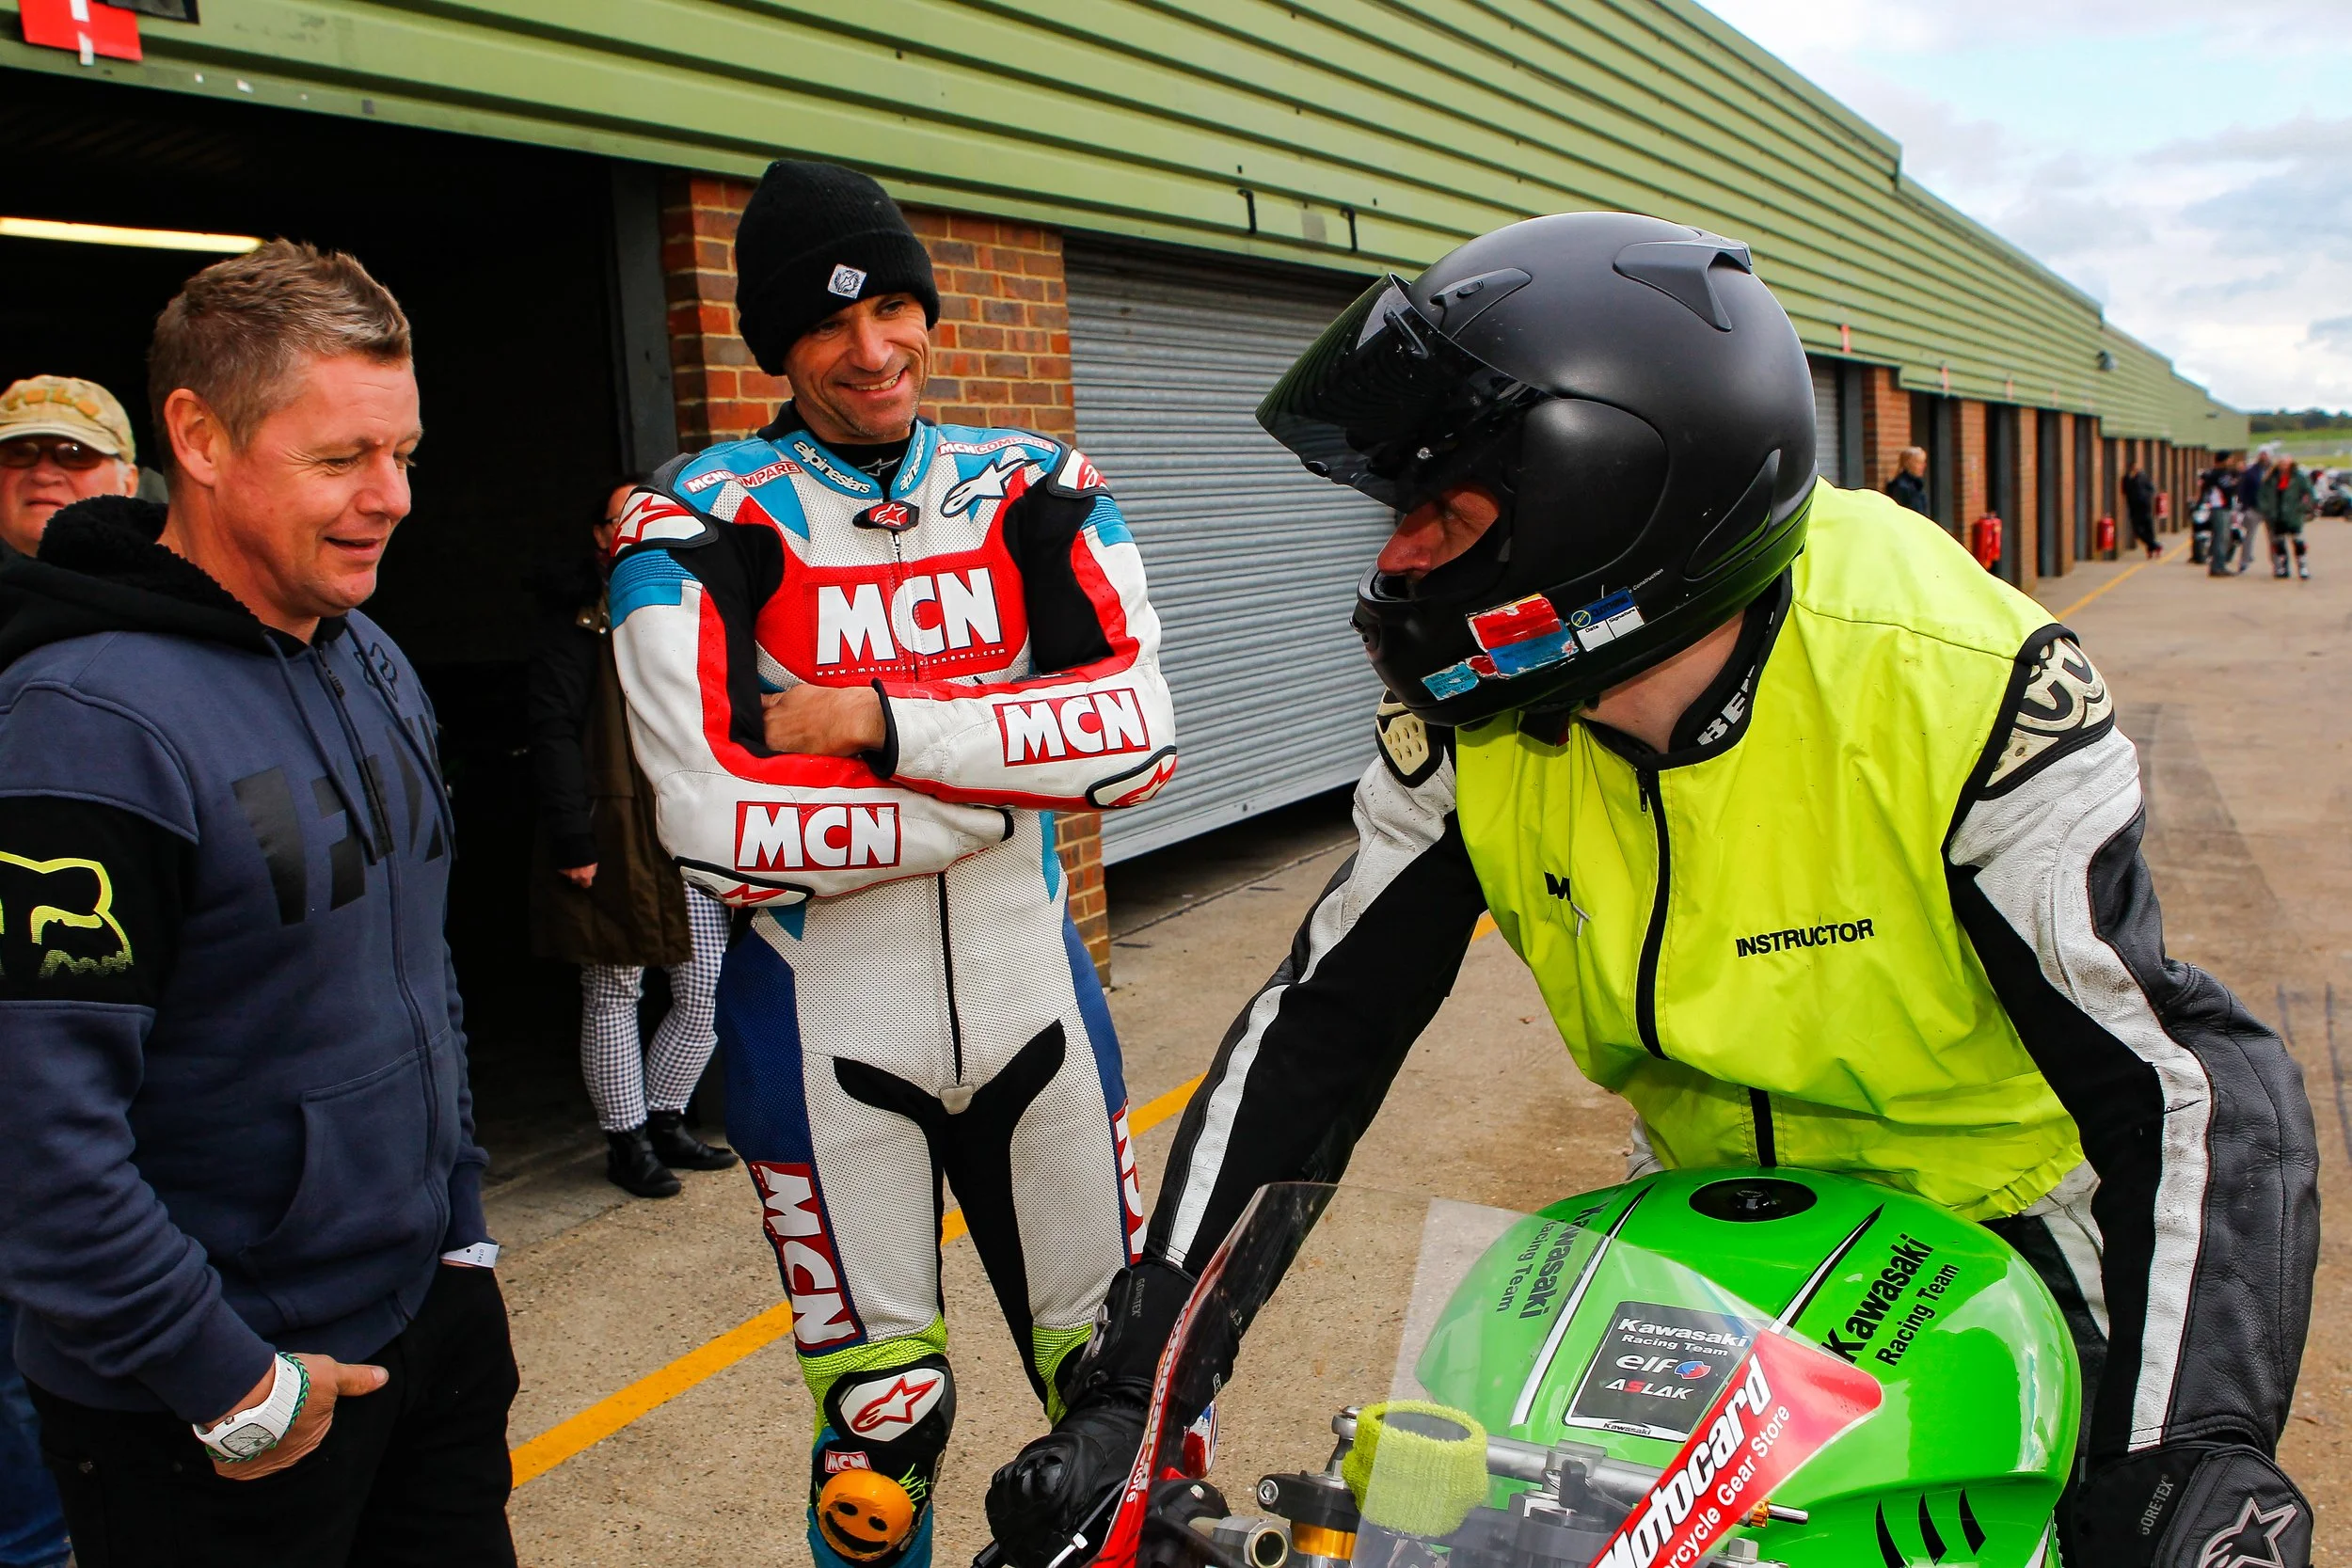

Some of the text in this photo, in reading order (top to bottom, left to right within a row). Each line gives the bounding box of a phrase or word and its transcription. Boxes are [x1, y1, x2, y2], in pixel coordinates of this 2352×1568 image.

[793, 440, 871, 494] alpinestars
[939, 442, 976, 455] MCN
[687, 462, 800, 493] MCN CMPARE
[816, 566, 1003, 666] MCN
[1584, 608, 1636, 634] Date Signature
[1002, 689, 1147, 764] MCN
[738, 801, 898, 870] MCN
[1735, 918, 1875, 958] INSTRUCTOR
[759, 1164, 857, 1345] MCN
[1496, 1263, 1534, 1313] Team
[1821, 1232, 1935, 1365] Kawasaki
[1617, 1318, 1750, 1348] Kawasaki
[1874, 1262, 1961, 1367] Racing Team
[1615, 1354, 1679, 1374] elf
[1621, 1334, 1729, 1356] Racing Team
[1605, 1378, 1694, 1401] ASLAK
[1602, 1421, 1652, 1436] Kawasaki
[827, 1453, 868, 1472] MCN
[1717, 1454, 1757, 1507] Gear
[1751, 1404, 1790, 1459] Store
